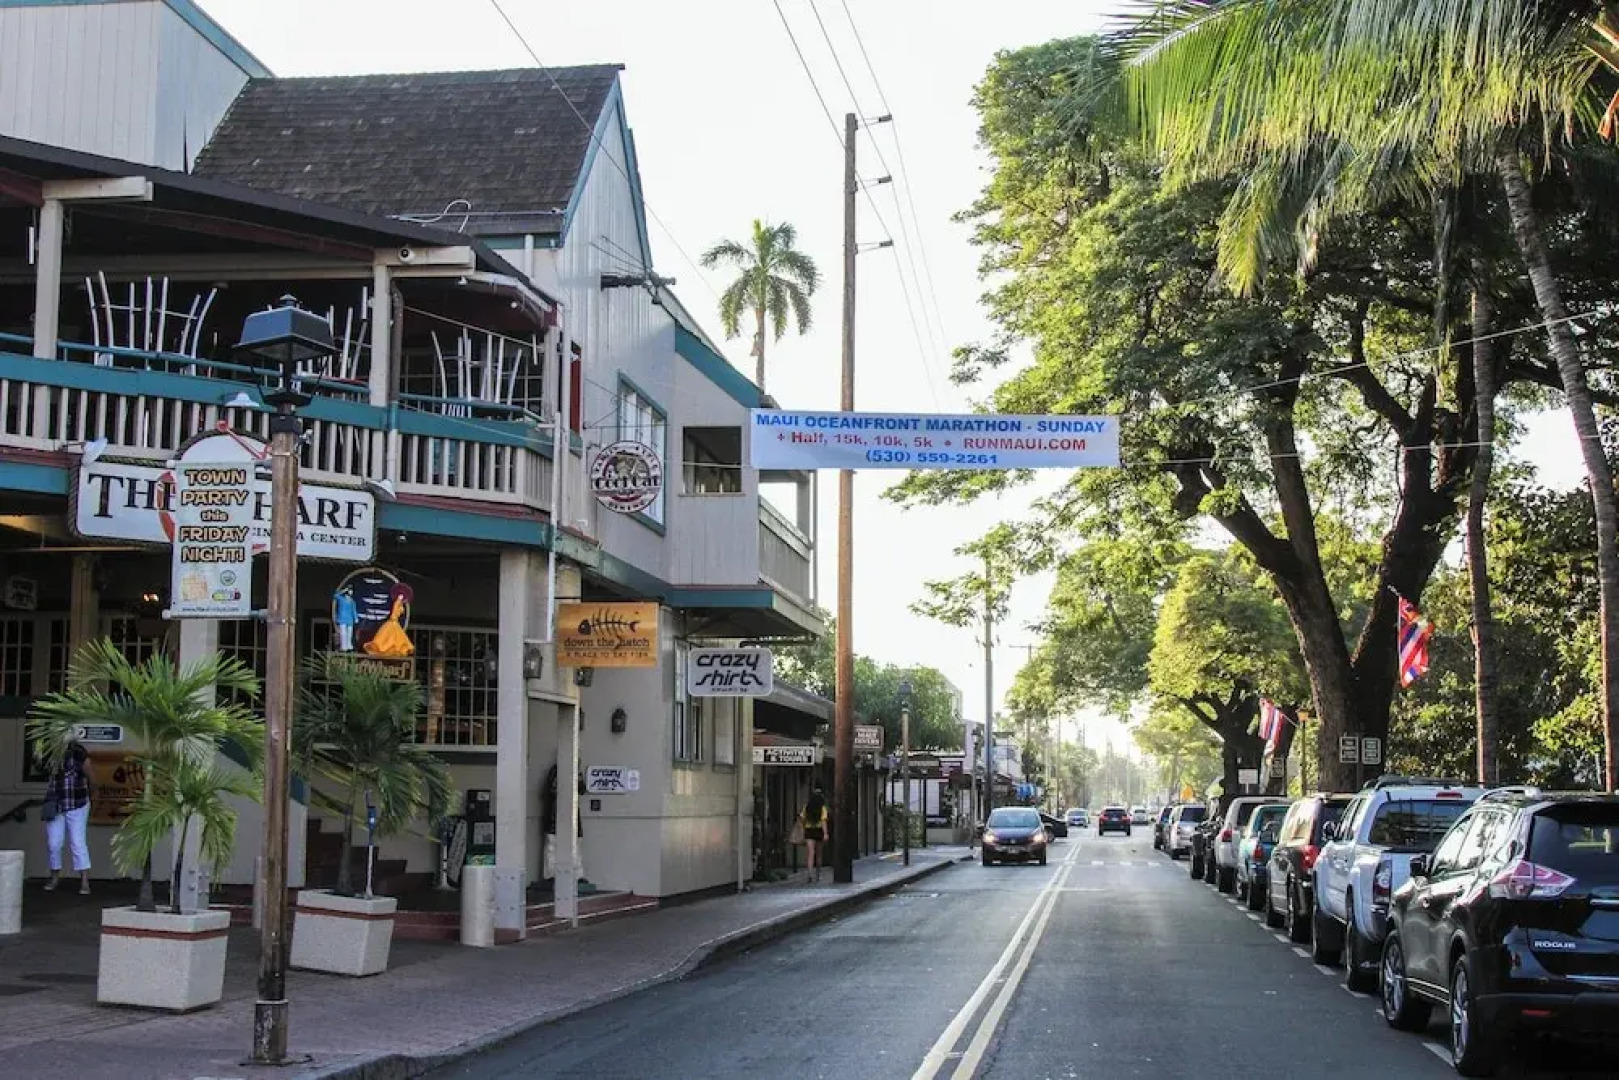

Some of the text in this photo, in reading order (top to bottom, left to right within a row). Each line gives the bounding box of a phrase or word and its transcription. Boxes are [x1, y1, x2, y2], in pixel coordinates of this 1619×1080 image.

[756, 414, 799, 426] MAUI
[805, 416, 921, 430] OCEANFRONT
[926, 418, 1021, 432] MARATHON
[1037, 420, 1105, 433] SUNDAY
[834, 433, 867, 445] 15k,
[874, 435, 907, 448] 10k,
[914, 436, 932, 447] 5k
[964, 438, 1086, 450] RUNMAUI.COM
[866, 449, 997, 464] (530) 559-2261
[185, 468, 246, 486] TOWN
[181, 489, 249, 507] PARTY
[201, 509, 229, 522] this
[179, 526, 250, 543] FRIDAY
[311, 532, 367, 547] CENTER
[181, 546, 246, 563] NIGHT!
[565, 637, 594, 647] down
[597, 637, 615, 647] the
[697, 653, 760, 671] crazy
[591, 769, 622, 779] crazy
[1534, 940, 1576, 949] ROGUE
